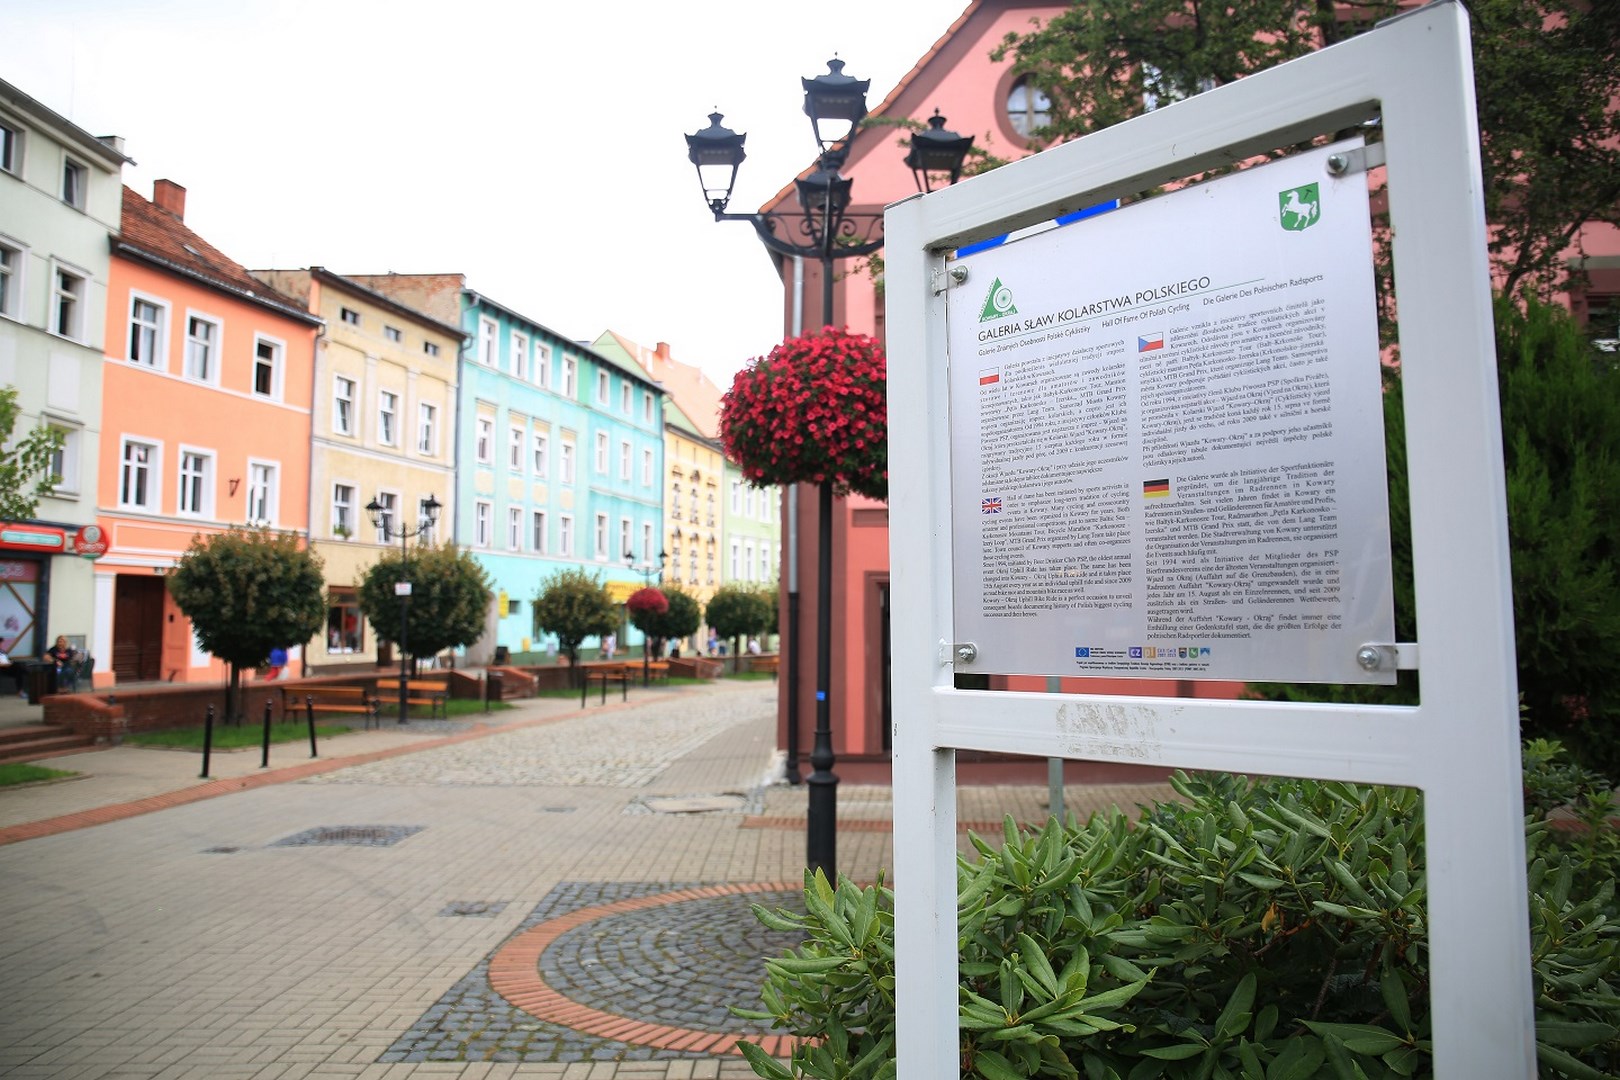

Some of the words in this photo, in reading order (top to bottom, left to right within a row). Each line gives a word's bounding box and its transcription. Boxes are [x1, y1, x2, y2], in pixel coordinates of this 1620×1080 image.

[1202, 295, 1214, 305] Die
[1215, 291, 1238, 302] Galerie
[1238, 287, 1252, 297] Des
[1253, 279, 1287, 293] Polnischen
[1288, 271, 1323, 287] Radsports
[979, 323, 1021, 341] GALERIA
[1025, 315, 1055, 330] SŁAW
[1058, 296, 1132, 322] KOLARSTWA
[1136, 277, 1211, 304] POLSKIEGO
[1114, 316, 1122, 325] Of
[1139, 311, 1148, 320] Of
[1148, 306, 1166, 317] Polish
[1167, 302, 1189, 315] Cycling
[1294, 488, 1320, 497] Kowary
[1305, 478, 1334, 487] Kowary
